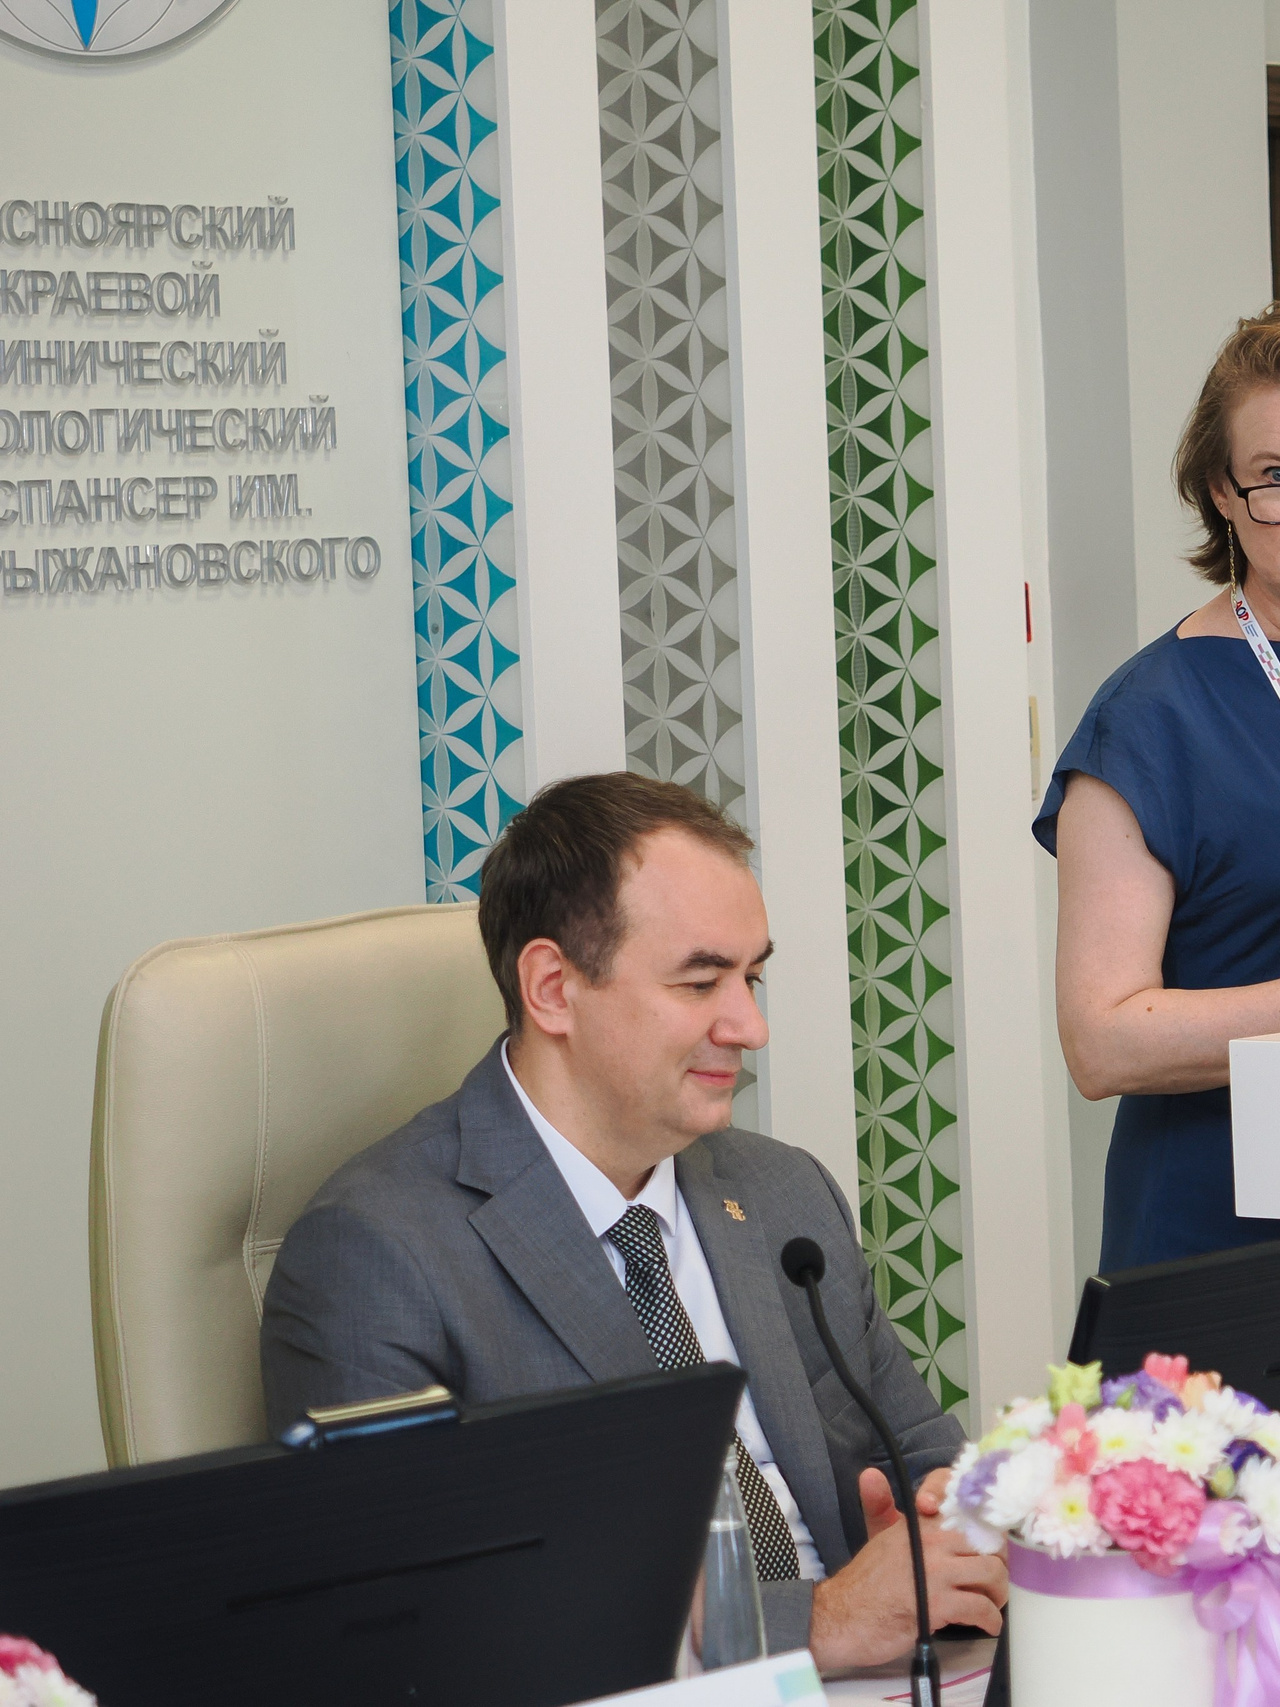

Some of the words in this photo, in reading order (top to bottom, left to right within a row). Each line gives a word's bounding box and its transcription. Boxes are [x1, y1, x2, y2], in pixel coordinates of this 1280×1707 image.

[0, 194, 296, 250] СНОЯРСКИЙ
[0, 260, 221, 318] КРАЕВОЙ
[0, 328, 287, 386] ИНИЧЕСКИЙ
[228, 473, 312, 520] ИМ.
[0, 535, 382, 596] ЫЖАНОВСКОГО
